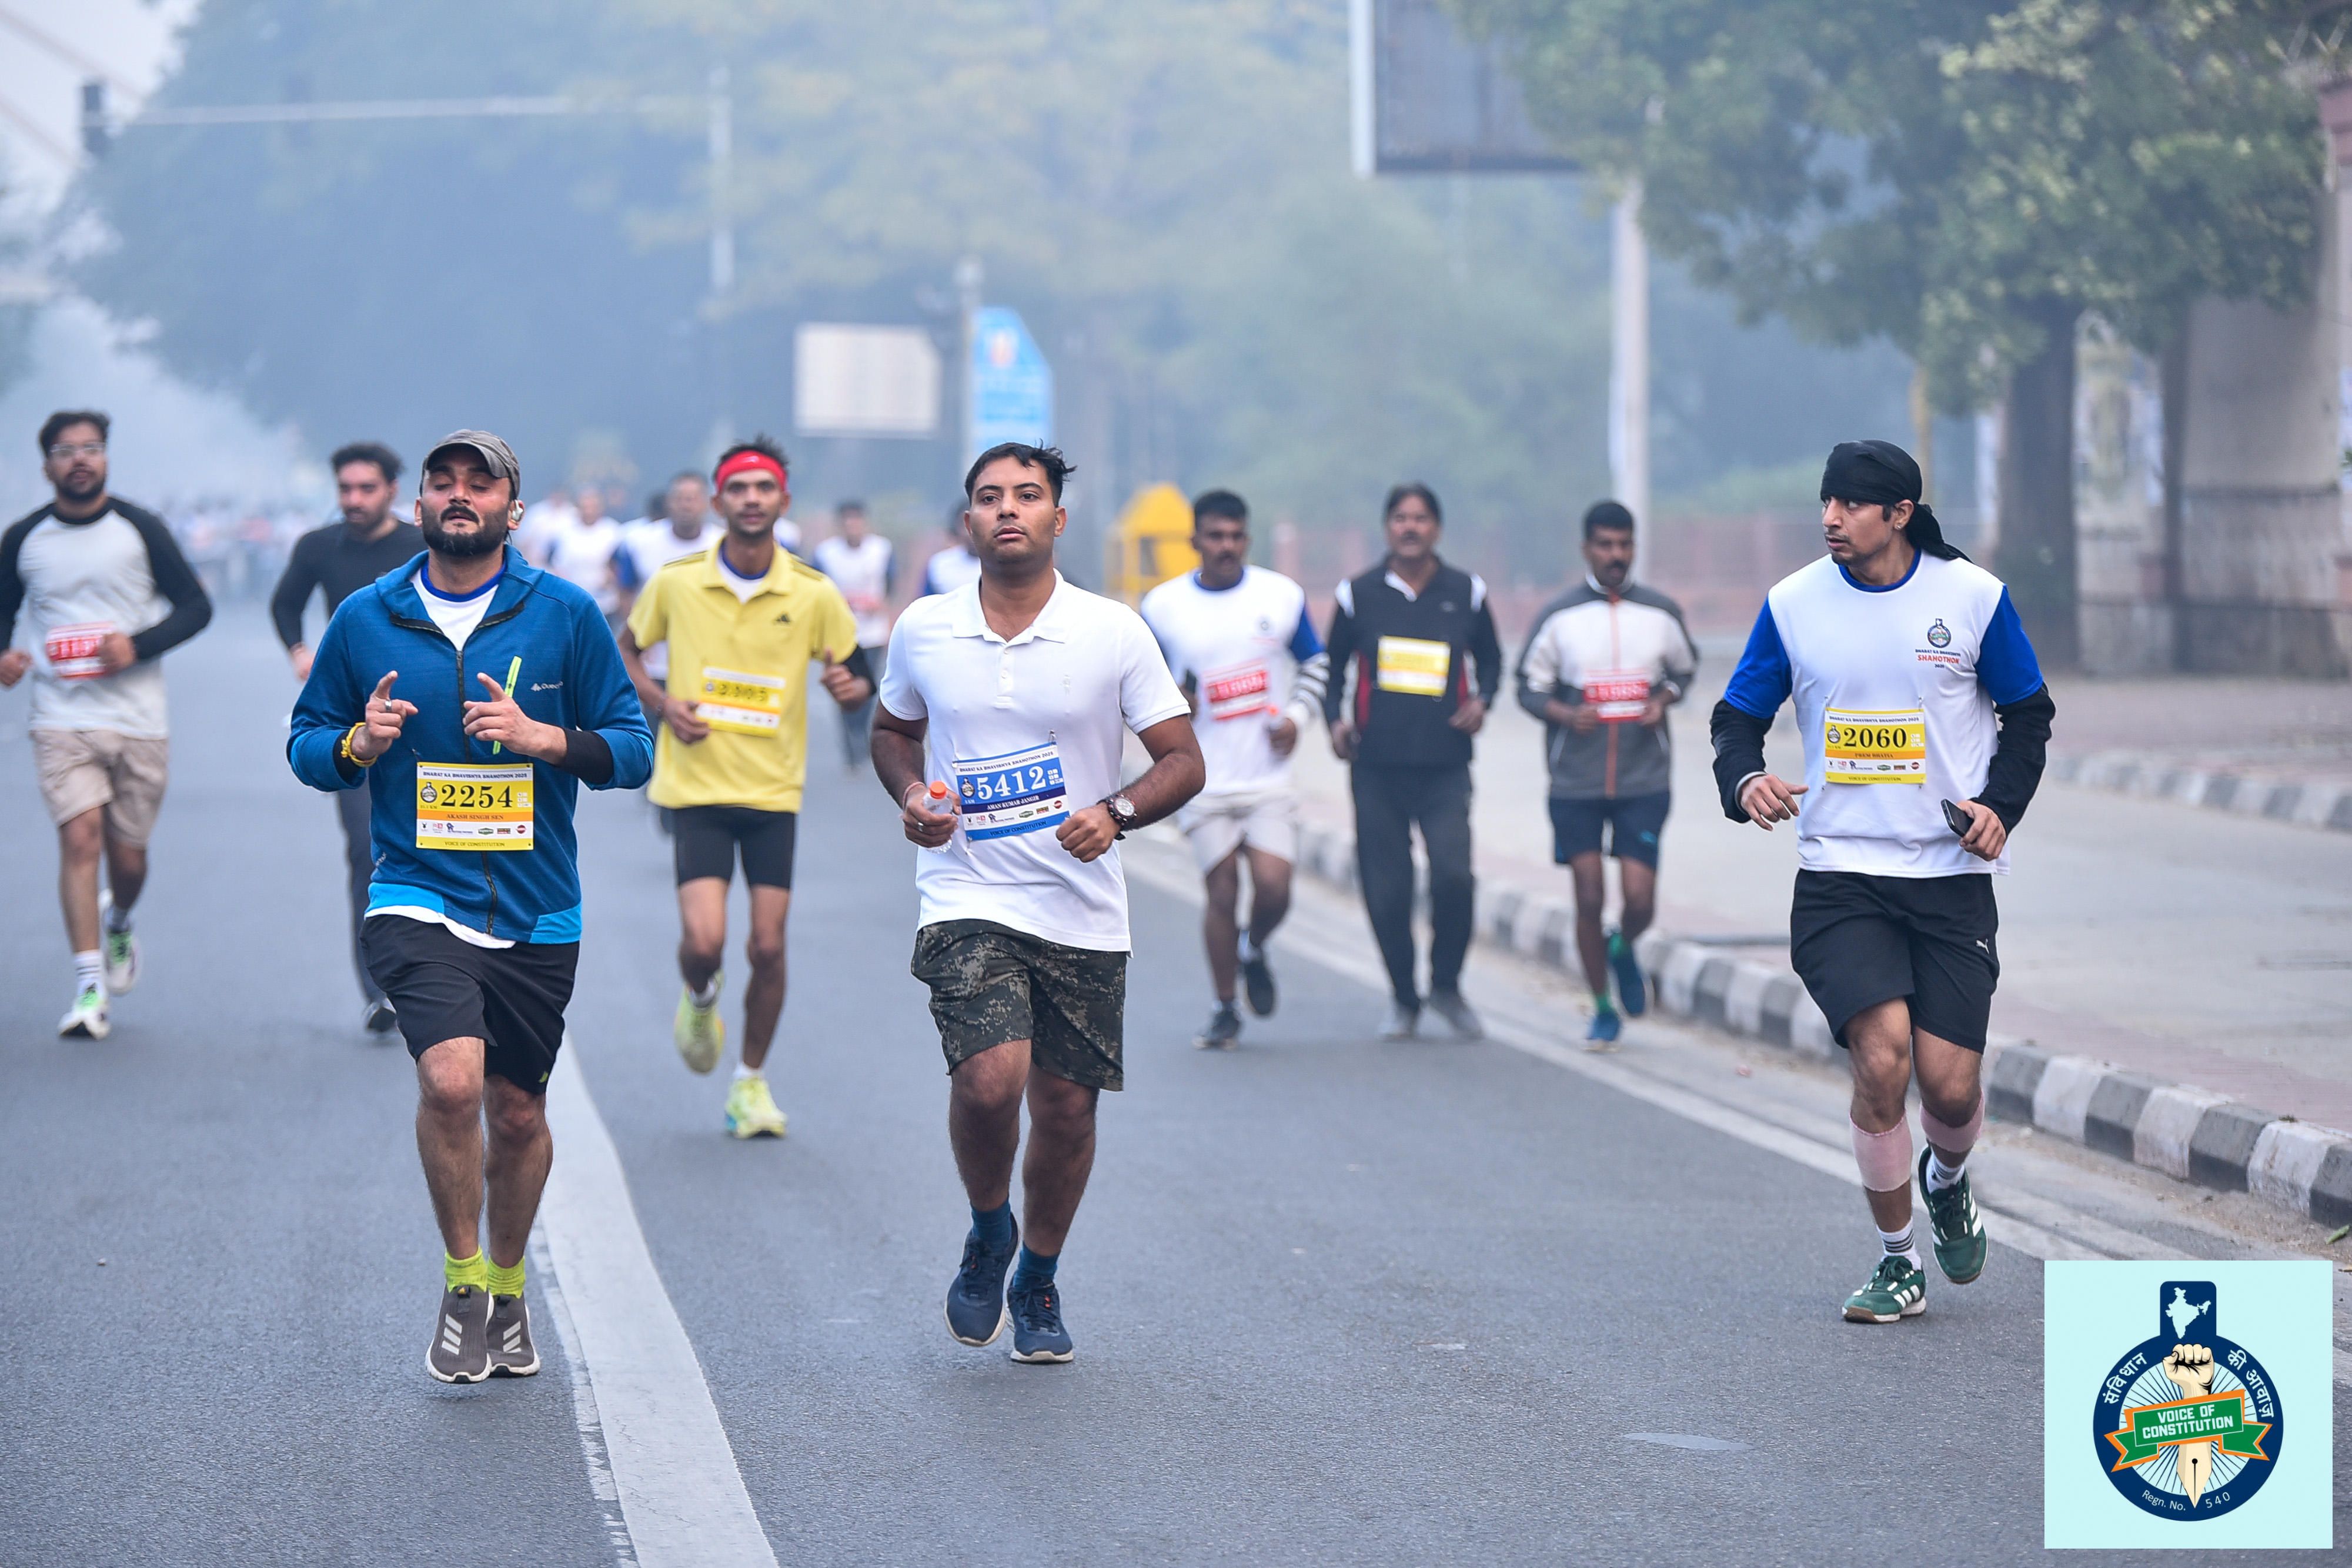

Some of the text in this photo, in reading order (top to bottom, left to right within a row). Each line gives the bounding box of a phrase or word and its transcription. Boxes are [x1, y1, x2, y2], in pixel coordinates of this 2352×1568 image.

[1843, 727, 1907, 748] 2060
[976, 765, 1047, 800] 5412
[440, 784, 513, 808] 2254
[1001, 800, 1021, 808] KUMAR
[1011, 820, 1047, 832] CONSTITUTION
